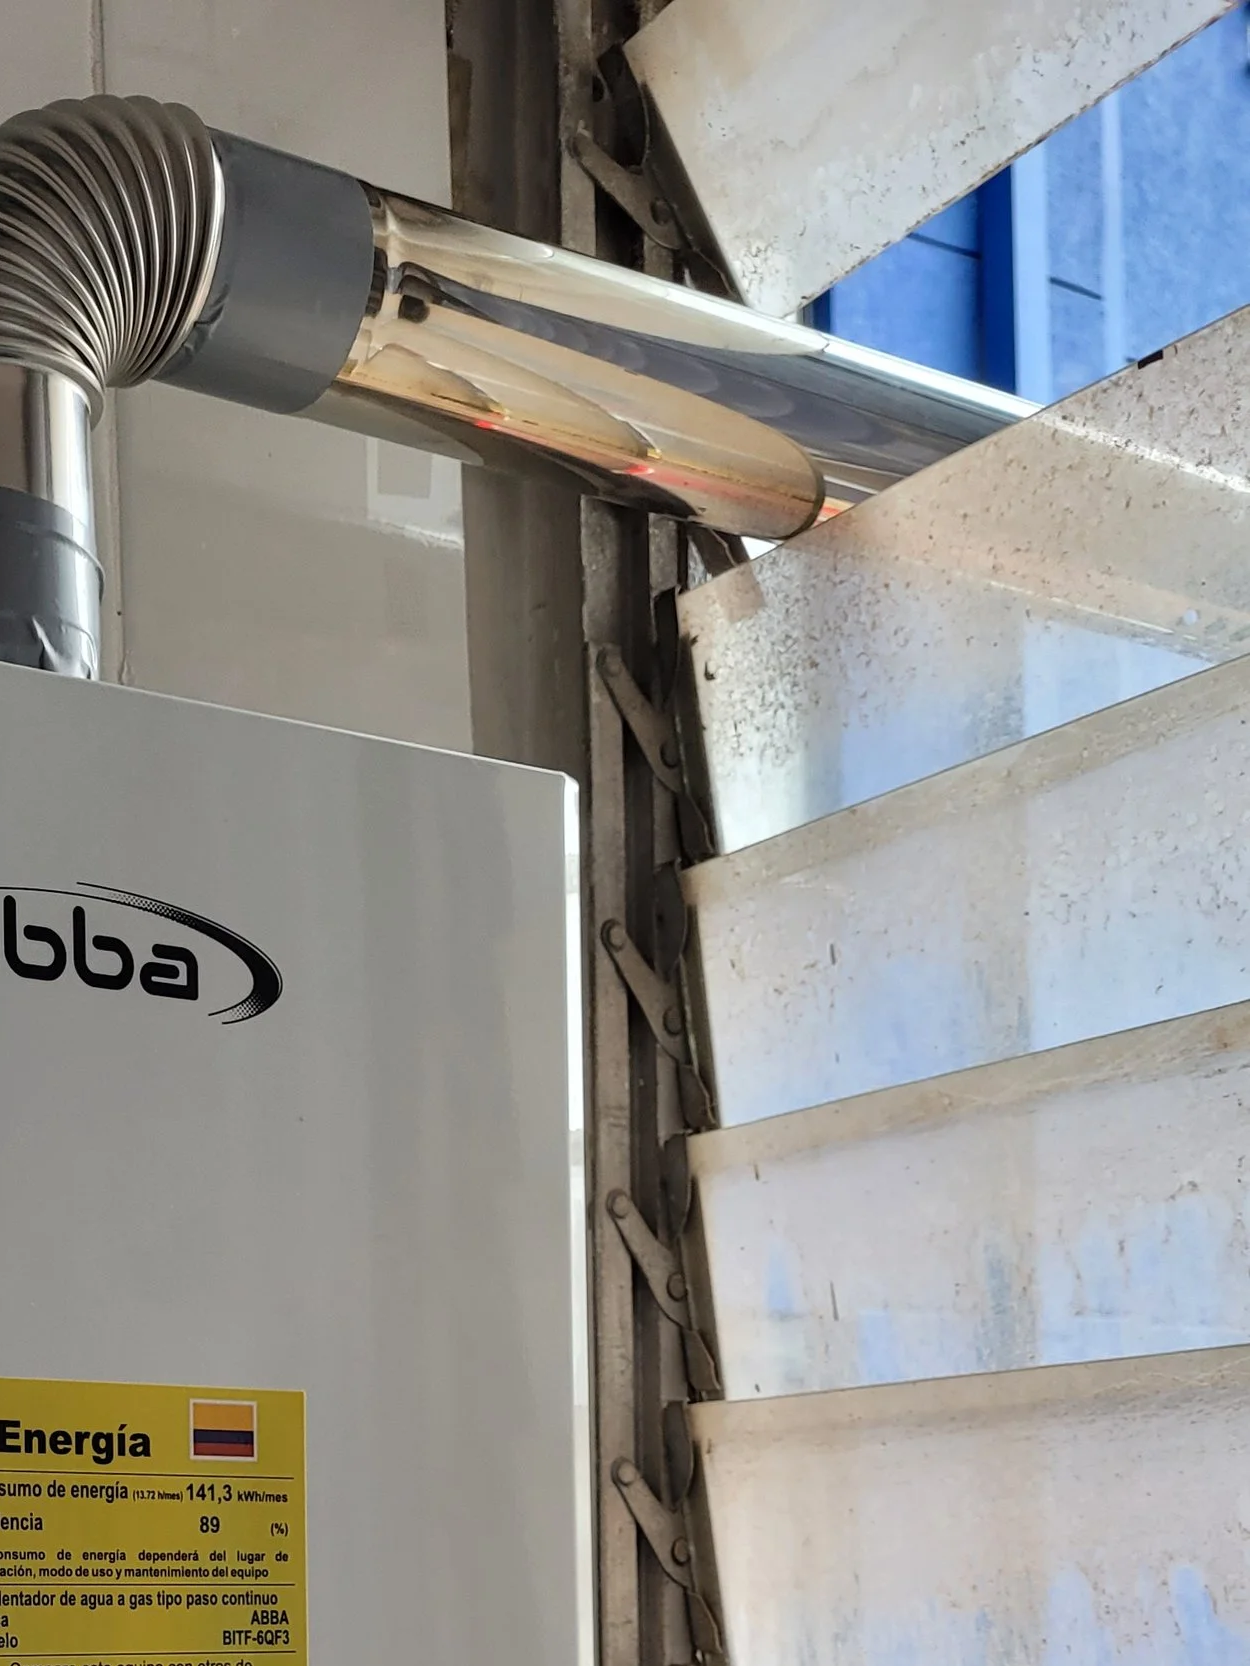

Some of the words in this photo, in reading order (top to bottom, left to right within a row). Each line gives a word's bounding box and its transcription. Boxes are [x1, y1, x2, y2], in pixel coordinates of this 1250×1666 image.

[47, 1480, 66, 1498] de
[71, 1481, 128, 1503] energía
[133, 1490, 156, 1502] (13.72
[186, 1483, 232, 1504] 141,3
[237, 1490, 288, 1503] kWh/mes
[200, 1516, 220, 1533] 89
[270, 1523, 288, 1537] (%)
[57, 1549, 72, 1560] de
[82, 1549, 126, 1563] energía
[138, 1549, 199, 1564] dependerá
[209, 1550, 226, 1561] del
[237, 1550, 266, 1564] lugar
[275, 1551, 288, 1562] de
[39, 1565, 73, 1577] modo
[75, 1565, 89, 1577] de
[92, 1568, 113, 1577] uso
[115, 1568, 122, 1580] y
[124, 1566, 210, 1578] mantenimiento
[211, 1566, 228, 1577] del
[230, 1566, 269, 1580] equipo
[60, 1590, 76, 1606] de
[80, 1594, 113, 1610] agua
[117, 1594, 125, 1606] a
[129, 1594, 153, 1610] gas
[157, 1590, 182, 1610] tipo
[186, 1594, 218, 1609] paso
[222, 1590, 278, 1605] continuo
[251, 1610, 289, 1625] ABBA
[223, 1629, 290, 1646] BITF-6QF3
